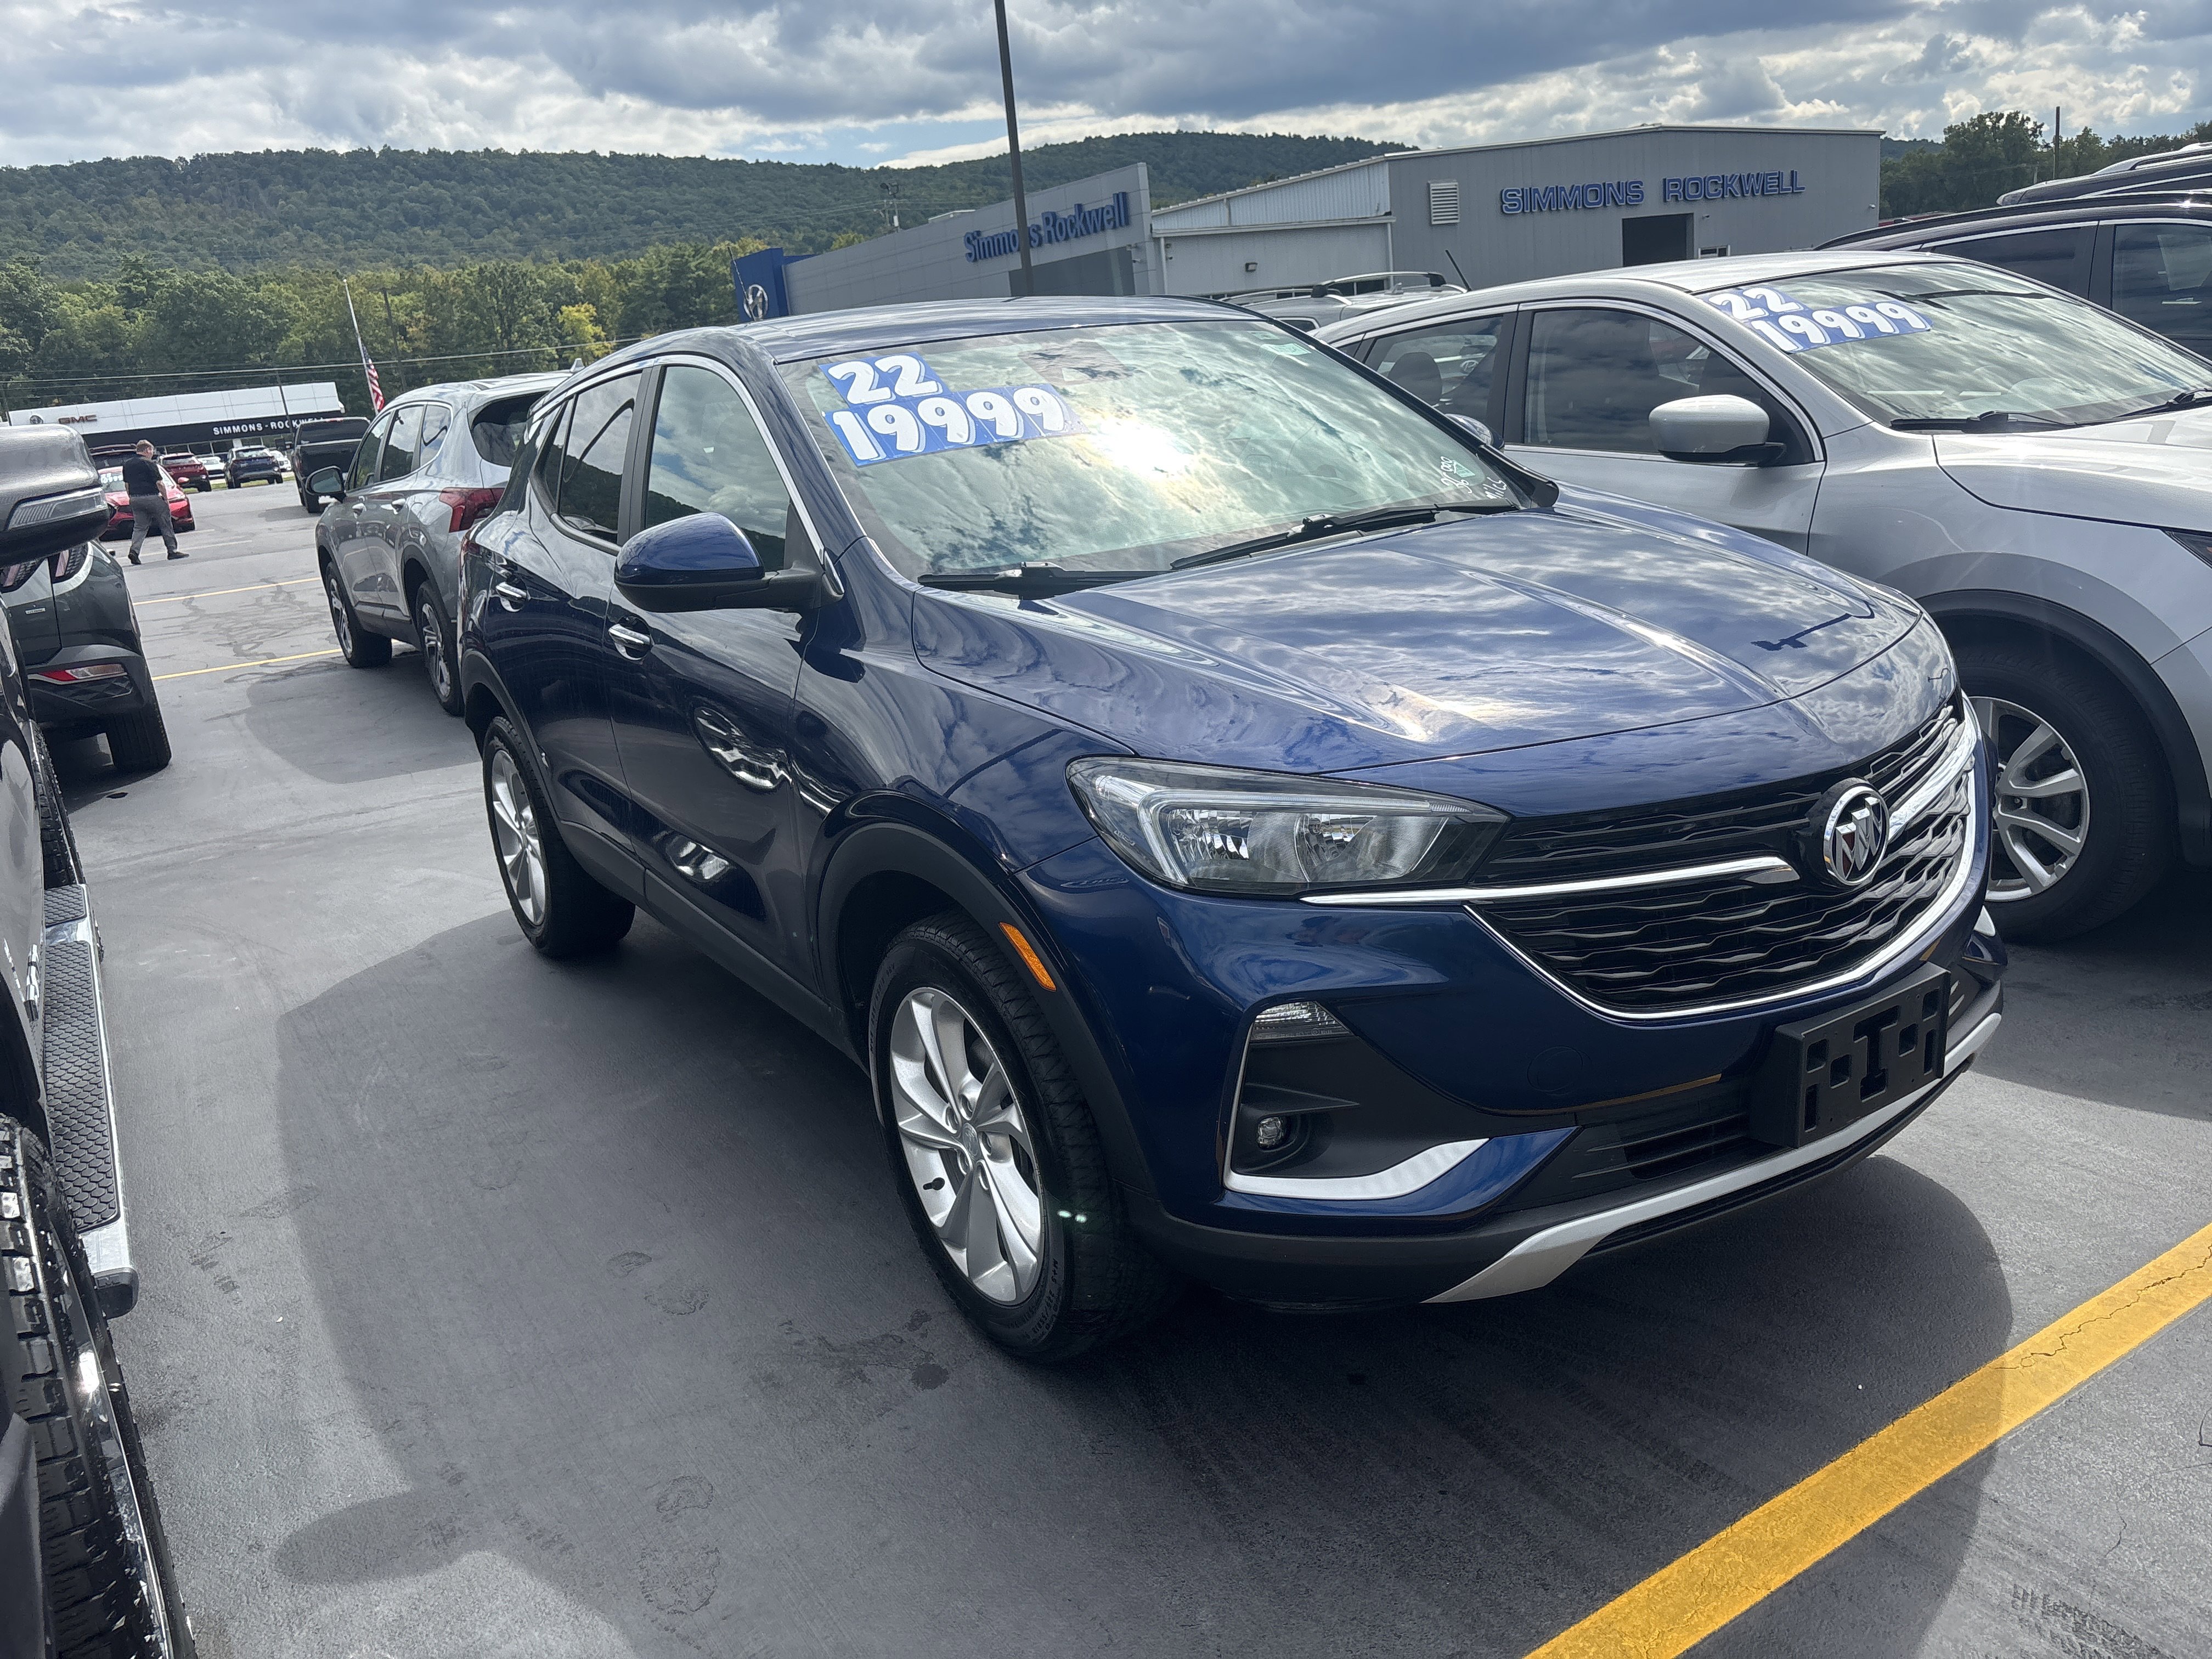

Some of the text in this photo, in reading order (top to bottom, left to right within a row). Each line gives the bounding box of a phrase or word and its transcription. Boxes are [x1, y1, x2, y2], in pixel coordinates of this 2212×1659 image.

[1500, 169, 1807, 215] SIMMONS ROCKWELL
[963, 191, 1130, 262] Simmos Rockwell
[1708, 287, 1804, 320] 22
[1751, 302, 1933, 353] 19999
[828, 354, 943, 405] 22
[58, 414, 98, 424] GMC
[832, 386, 1069, 461] 19999
